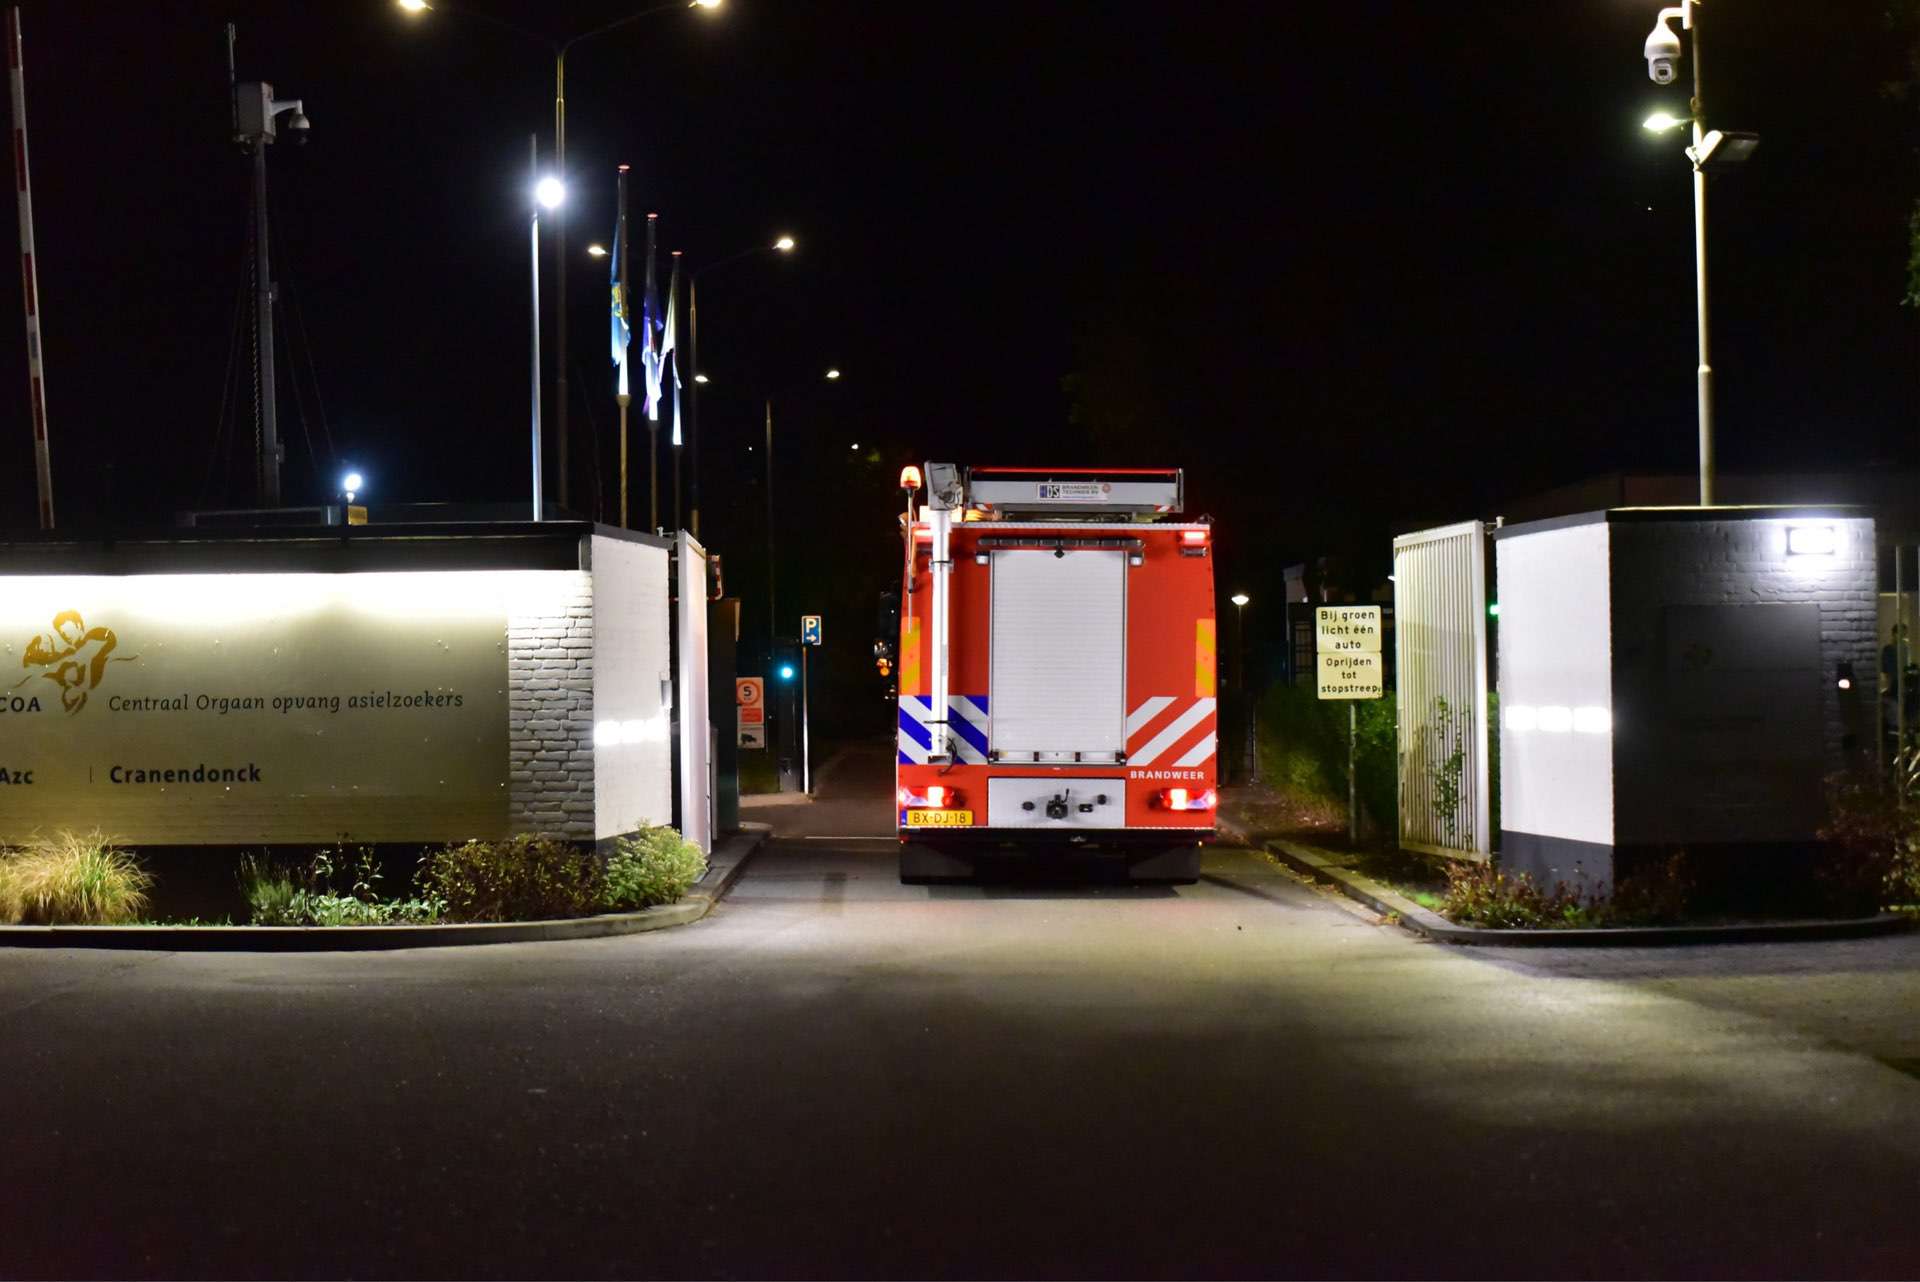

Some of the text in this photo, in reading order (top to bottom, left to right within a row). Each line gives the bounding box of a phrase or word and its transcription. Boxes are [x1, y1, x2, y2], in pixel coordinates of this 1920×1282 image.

[1321, 611, 1375, 622] Bij groen
[805, 618, 817, 633] P
[1321, 626, 1350, 635] licht
[1335, 640, 1361, 649] auto
[1326, 658, 1372, 668] Oprijden
[1341, 671, 1357, 679] tot
[743, 686, 752, 697] 5
[0, 689, 464, 715] COA Centraal Orgaan opvang asielzoekers
[0, 763, 262, 785] Azc Cranendonck
[1130, 770, 1204, 780] BRANDWEER
[913, 812, 967, 824] BX-DJ-18
